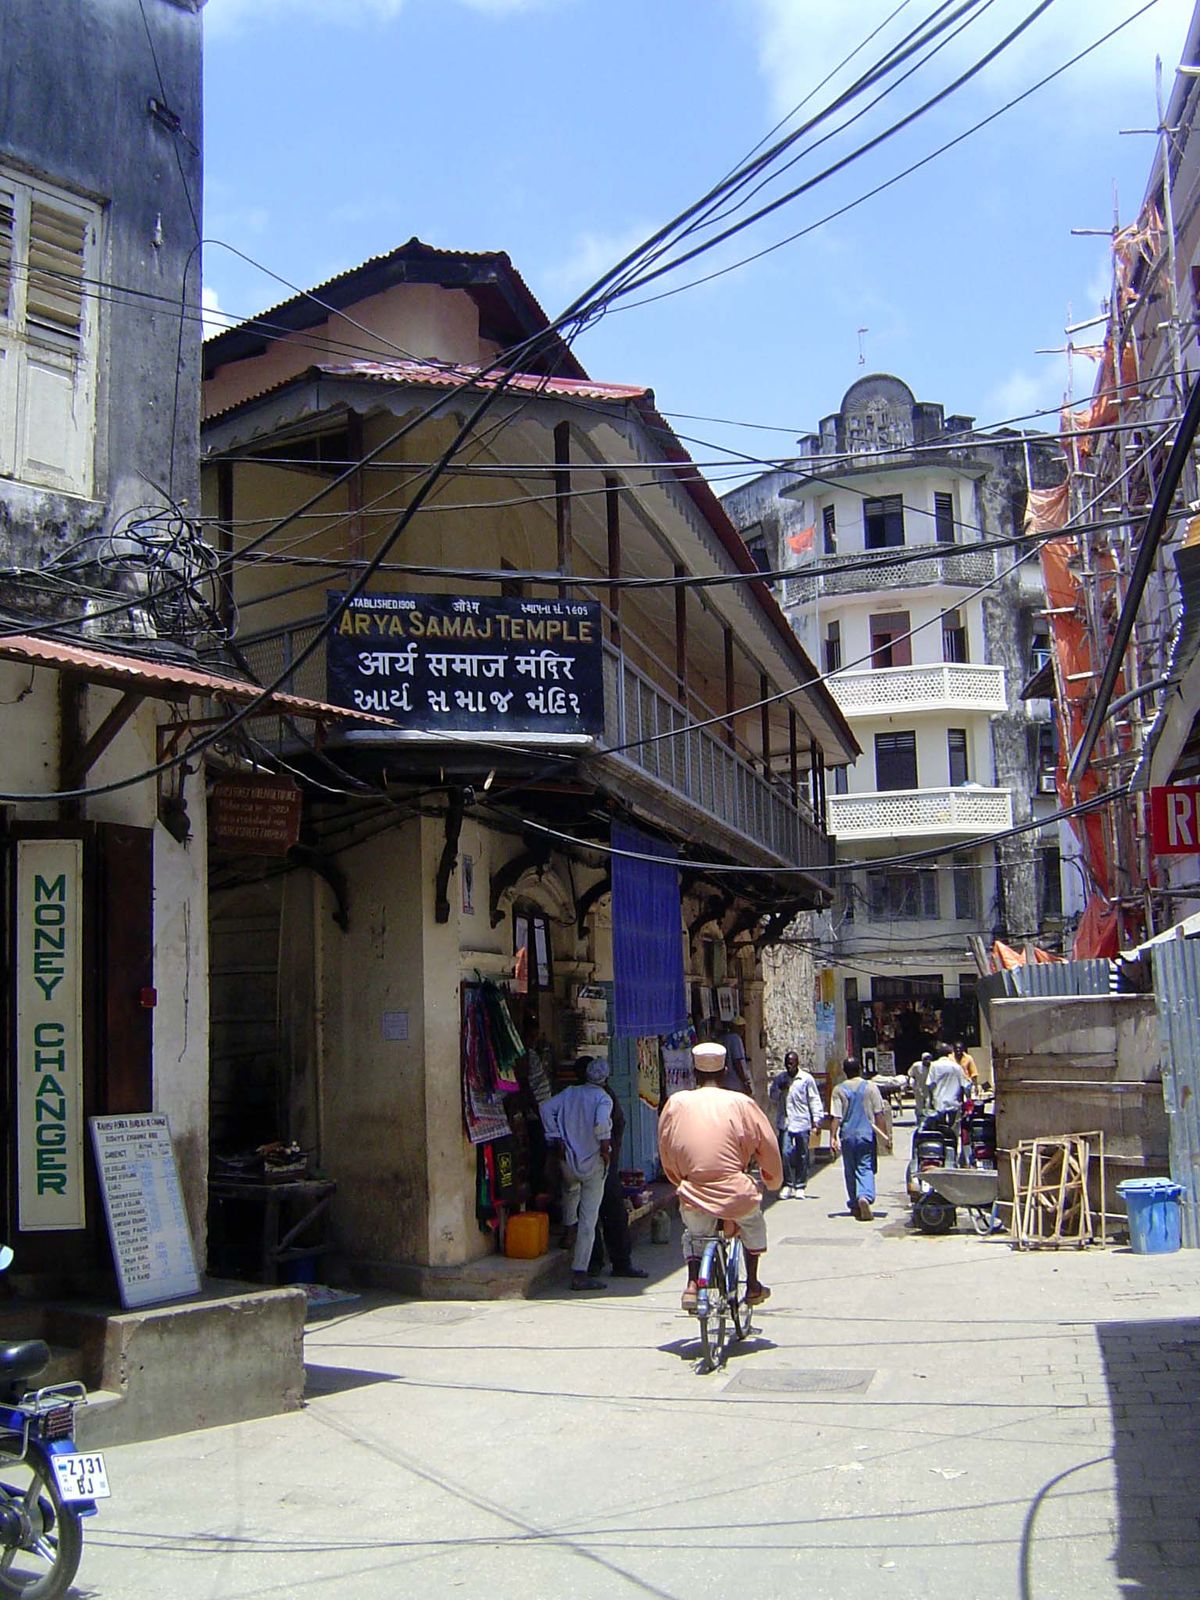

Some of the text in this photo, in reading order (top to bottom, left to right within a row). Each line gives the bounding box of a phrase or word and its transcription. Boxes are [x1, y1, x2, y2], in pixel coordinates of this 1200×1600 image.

[339, 609, 593, 641] ARYA SAMAJ TEMPLE
[358, 642, 576, 680] आर्य समाज मंदिर
[353, 682, 413, 711] આર્ય
[525, 685, 580, 714] મંદિર
[34, 874, 67, 1196] MONEY CHANGER
[67, 1457, 102, 1475] Z131
